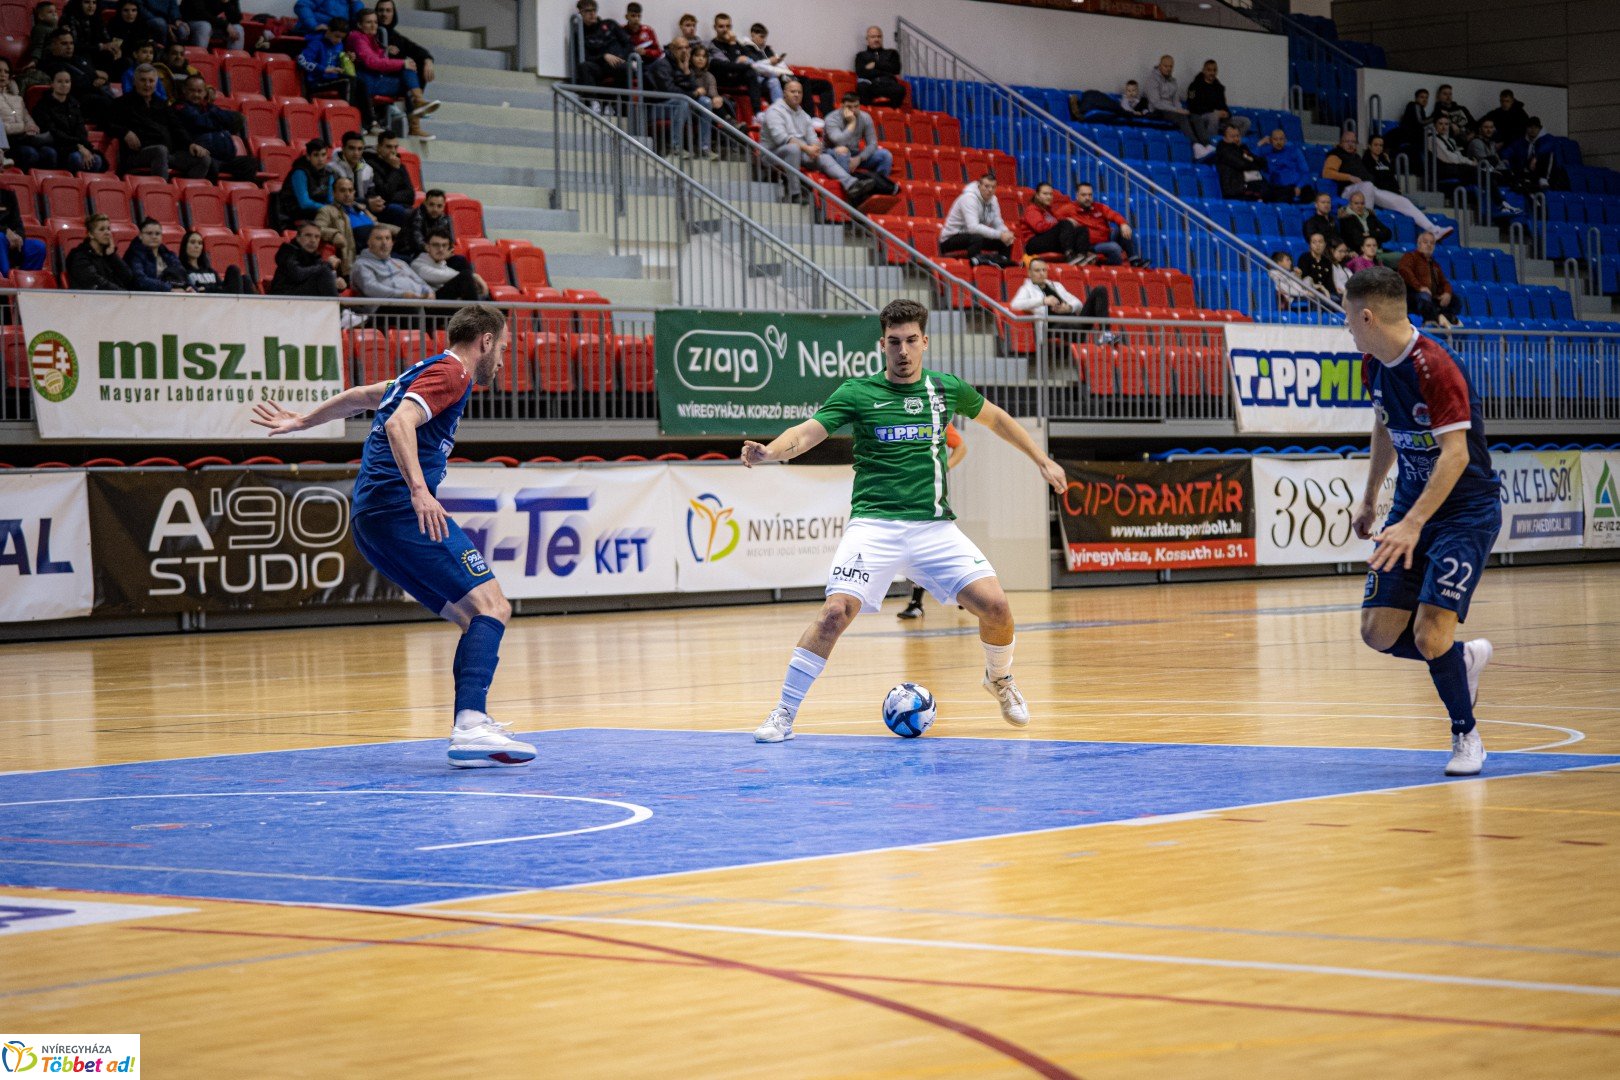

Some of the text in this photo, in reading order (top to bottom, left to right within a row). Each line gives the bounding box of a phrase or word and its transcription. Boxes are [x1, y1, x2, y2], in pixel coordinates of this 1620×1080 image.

[98, 334, 340, 381] mlsz.hu
[688, 340, 883, 383] ziaja Neked
[99, 385, 160, 403] Magyar
[168, 384, 254, 403] Labdarúgó
[1232, 355, 1371, 401] TiPPMI
[677, 401, 745, 419] NYÍREGYHÁZA
[746, 402, 782, 419] KORZÓ
[1513, 468, 1531, 504] AZ
[1533, 459, 1571, 503] ELSŐ!
[149, 487, 350, 551] A'90
[748, 513, 844, 541] NYÍREGYH
[1111, 519, 1242, 539] www.raktarsportbolt.hu
[1271, 476, 1354, 549] 383
[595, 537, 650, 574] KFT
[1154, 546, 1212, 562] Kossuth
[1214, 547, 1225, 560] u.
[1227, 544, 1248, 557] 31.
[149, 552, 345, 596] STUDIO
[1437, 557, 1473, 592] 22
[1440, 588, 1461, 600] JAKO
